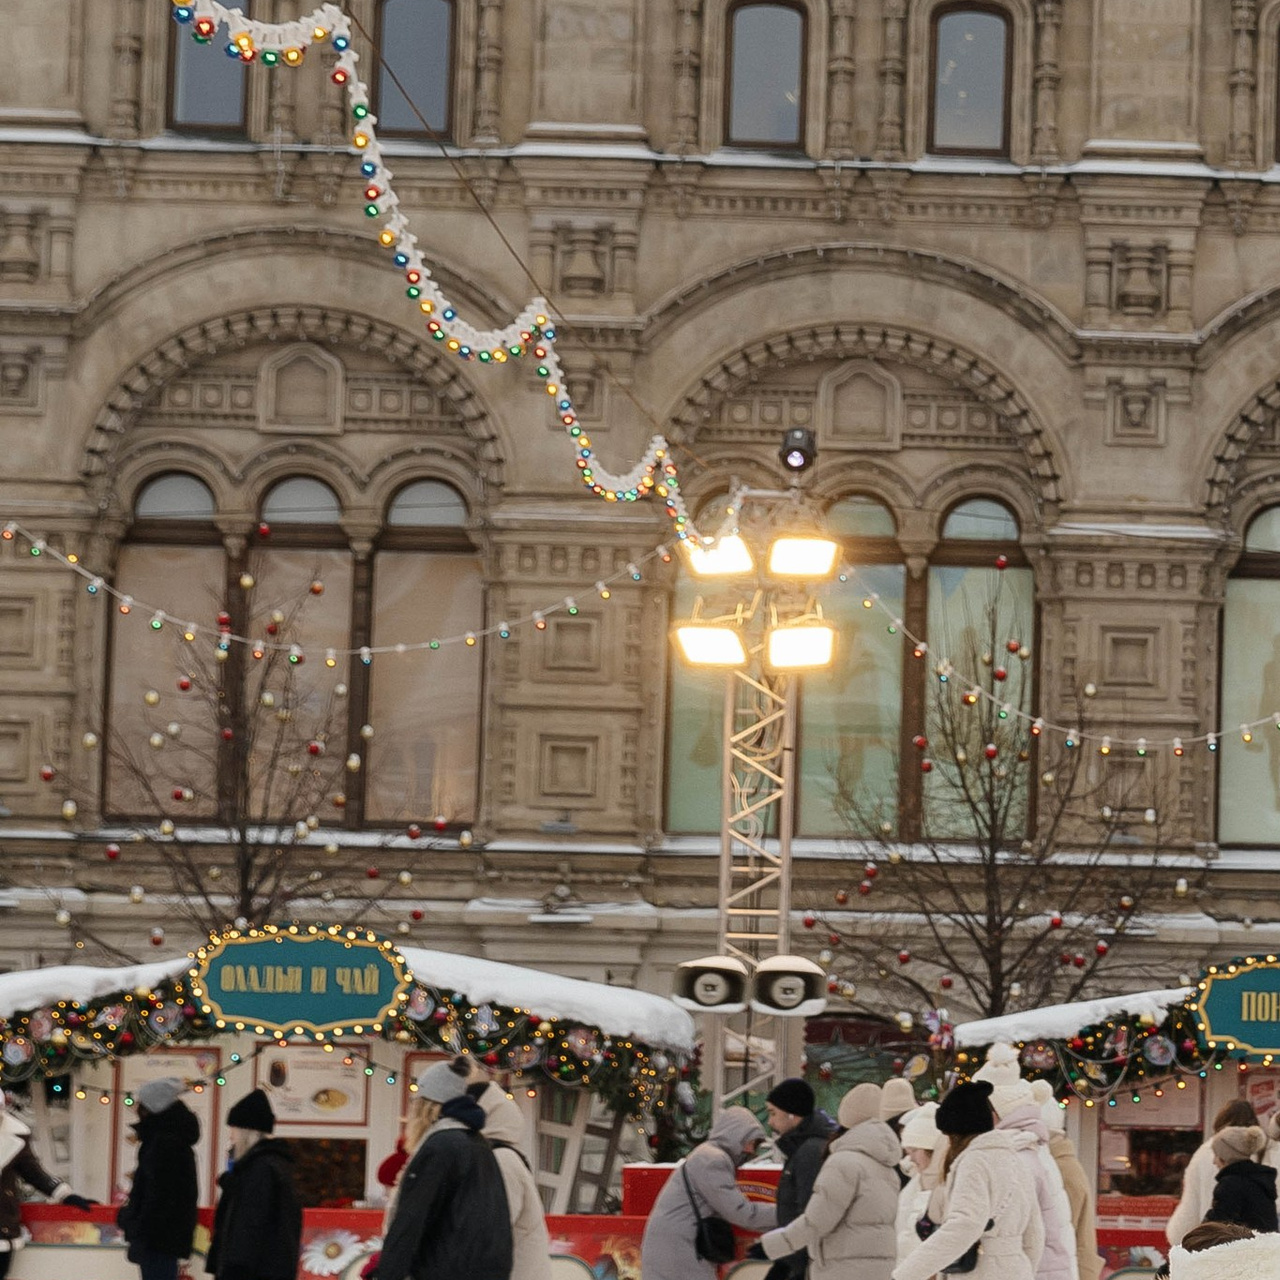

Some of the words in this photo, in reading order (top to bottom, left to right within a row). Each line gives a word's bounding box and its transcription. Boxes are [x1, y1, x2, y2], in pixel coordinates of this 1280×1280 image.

[221, 965, 302, 993] ОЛАДЬИ
[310, 967, 326, 994] И
[336, 964, 380, 994] ЧАЙ
